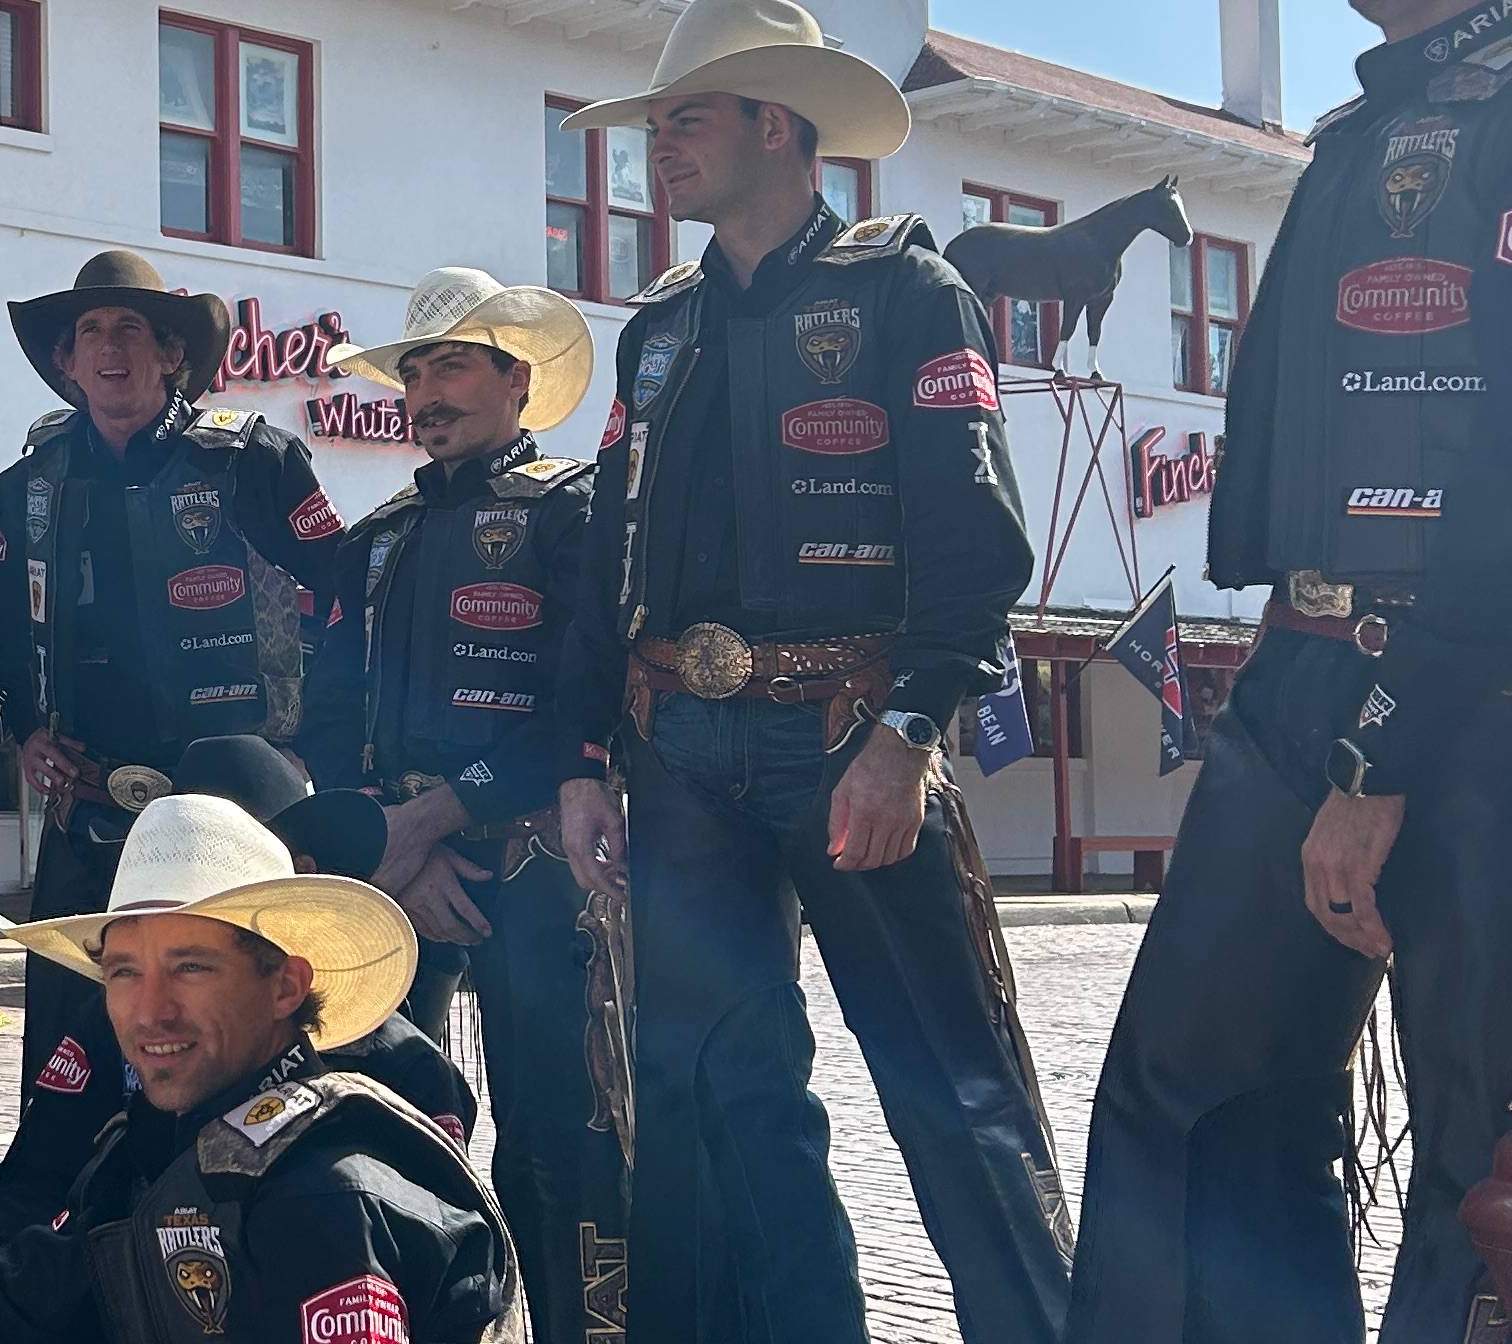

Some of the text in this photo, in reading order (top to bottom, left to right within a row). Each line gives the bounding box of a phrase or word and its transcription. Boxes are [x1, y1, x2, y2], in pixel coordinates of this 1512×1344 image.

[798, 205, 832, 257] ARIAT
[794, 308, 860, 335] RATTLERS
[788, 417, 886, 440] Community
[798, 542, 894, 560] can-am
[172, 575, 241, 601] Community
[192, 631, 253, 650] Land.com
[190, 684, 258, 701] can-am
[452, 688, 536, 706] can-am
[975, 705, 1009, 747] BEAN
[164, 1215, 209, 1226] TEXAS
[156, 1226, 225, 1258] RATTLERS
